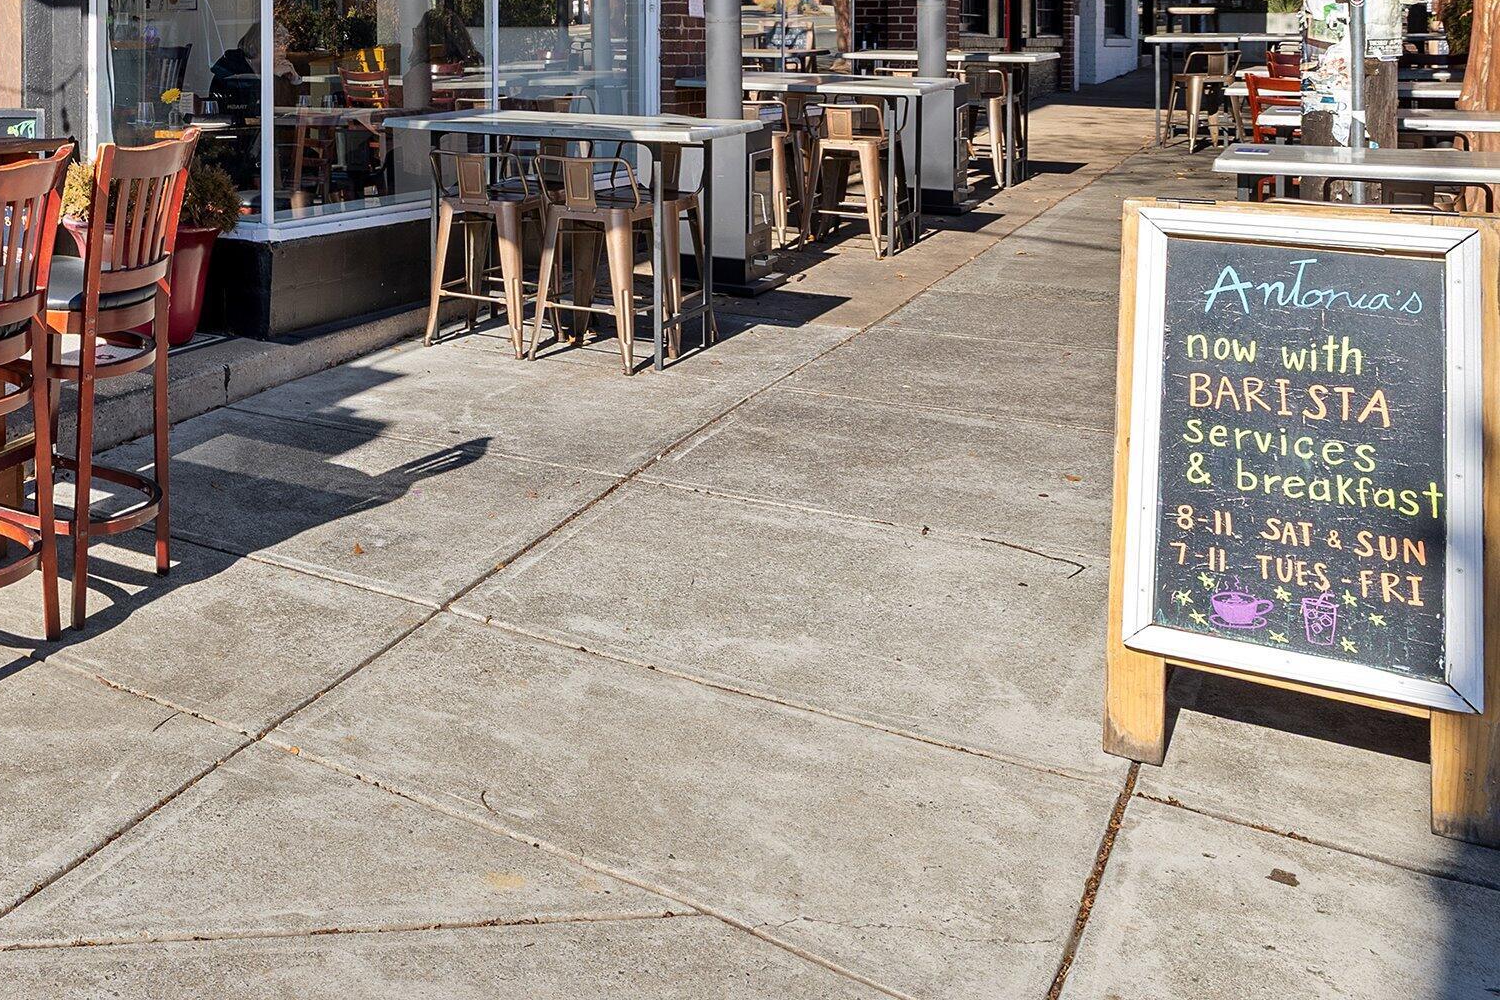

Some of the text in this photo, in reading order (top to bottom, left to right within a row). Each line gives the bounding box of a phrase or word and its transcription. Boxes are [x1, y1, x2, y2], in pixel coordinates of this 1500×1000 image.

[1186, 333, 1363, 375] now with
[1189, 372, 1391, 428] BARISTA
[1183, 418, 1376, 473] services
[1186, 452, 1443, 519] & breakfast
[1260, 517, 1312, 547] SAT
[1327, 529, 1343, 549] &
[1354, 530, 1426, 567] SUN
